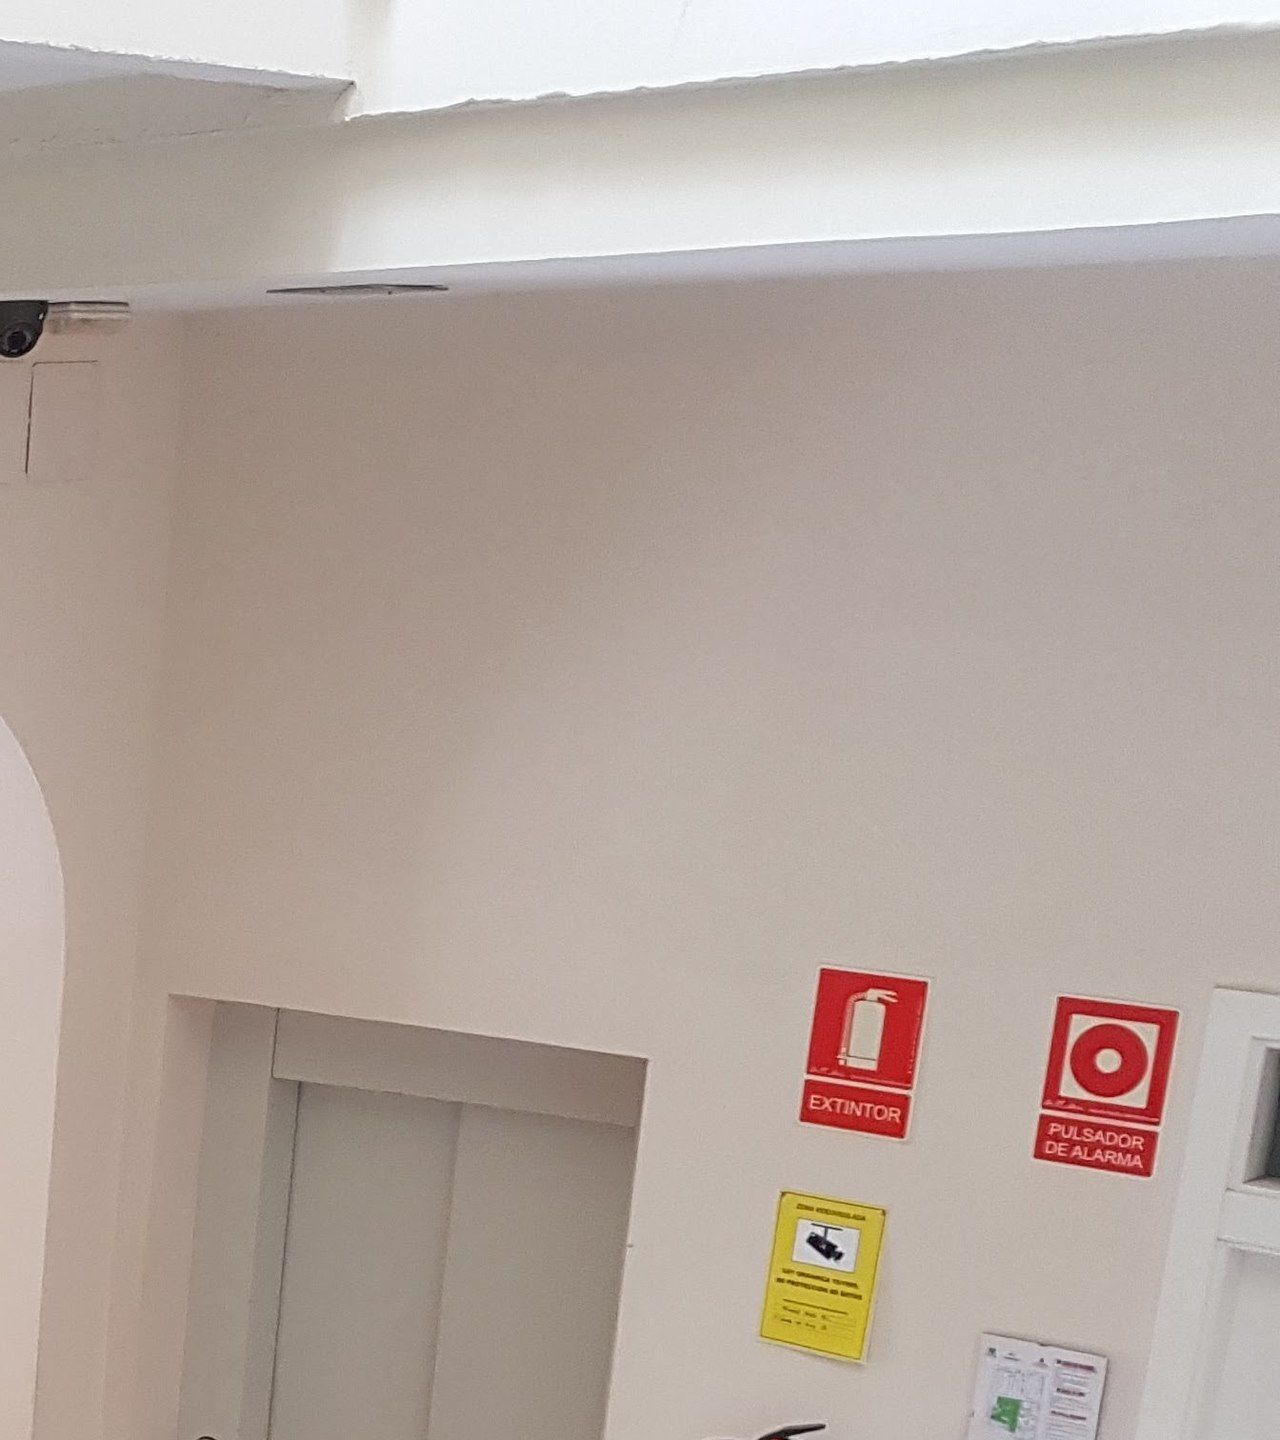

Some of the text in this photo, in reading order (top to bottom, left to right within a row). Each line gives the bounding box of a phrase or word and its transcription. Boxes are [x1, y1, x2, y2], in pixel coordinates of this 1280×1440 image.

[809, 1095, 902, 1124] EXTINTOR
[1048, 1123, 1145, 1150] PULSADOR
[1045, 1142, 1144, 1169] DE ALARMA
